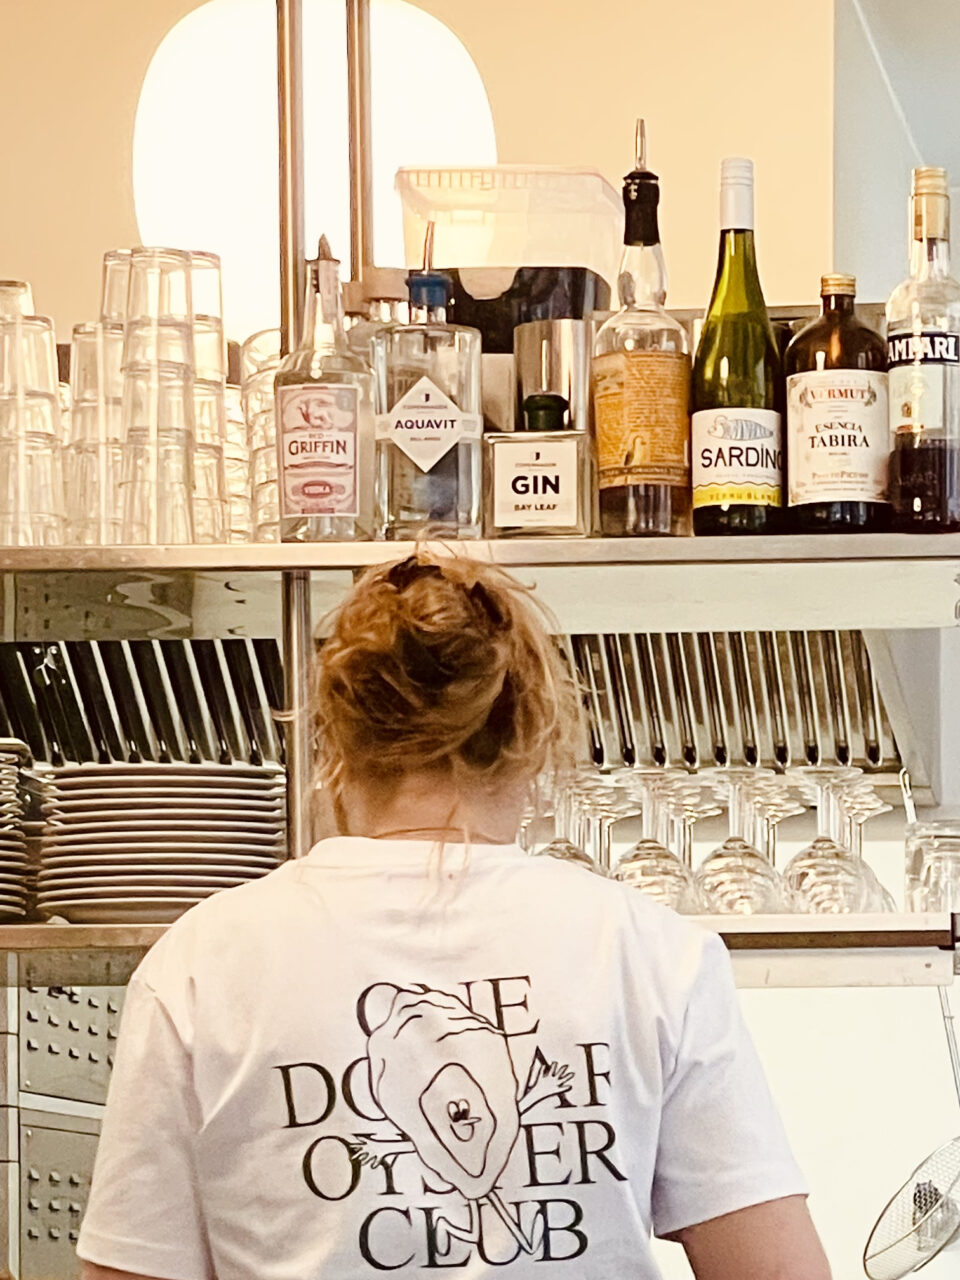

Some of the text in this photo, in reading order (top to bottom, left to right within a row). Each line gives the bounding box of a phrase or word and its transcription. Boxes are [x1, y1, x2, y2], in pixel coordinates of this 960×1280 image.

[394, 419, 457, 430] AQUAVIT
[815, 421, 863, 434] ESENCIA
[288, 440, 347, 456] GRIFFIN
[808, 434, 870, 449] TABIRA
[511, 475, 560, 495] GIN
[359, 1198, 588, 1270] CLUB
